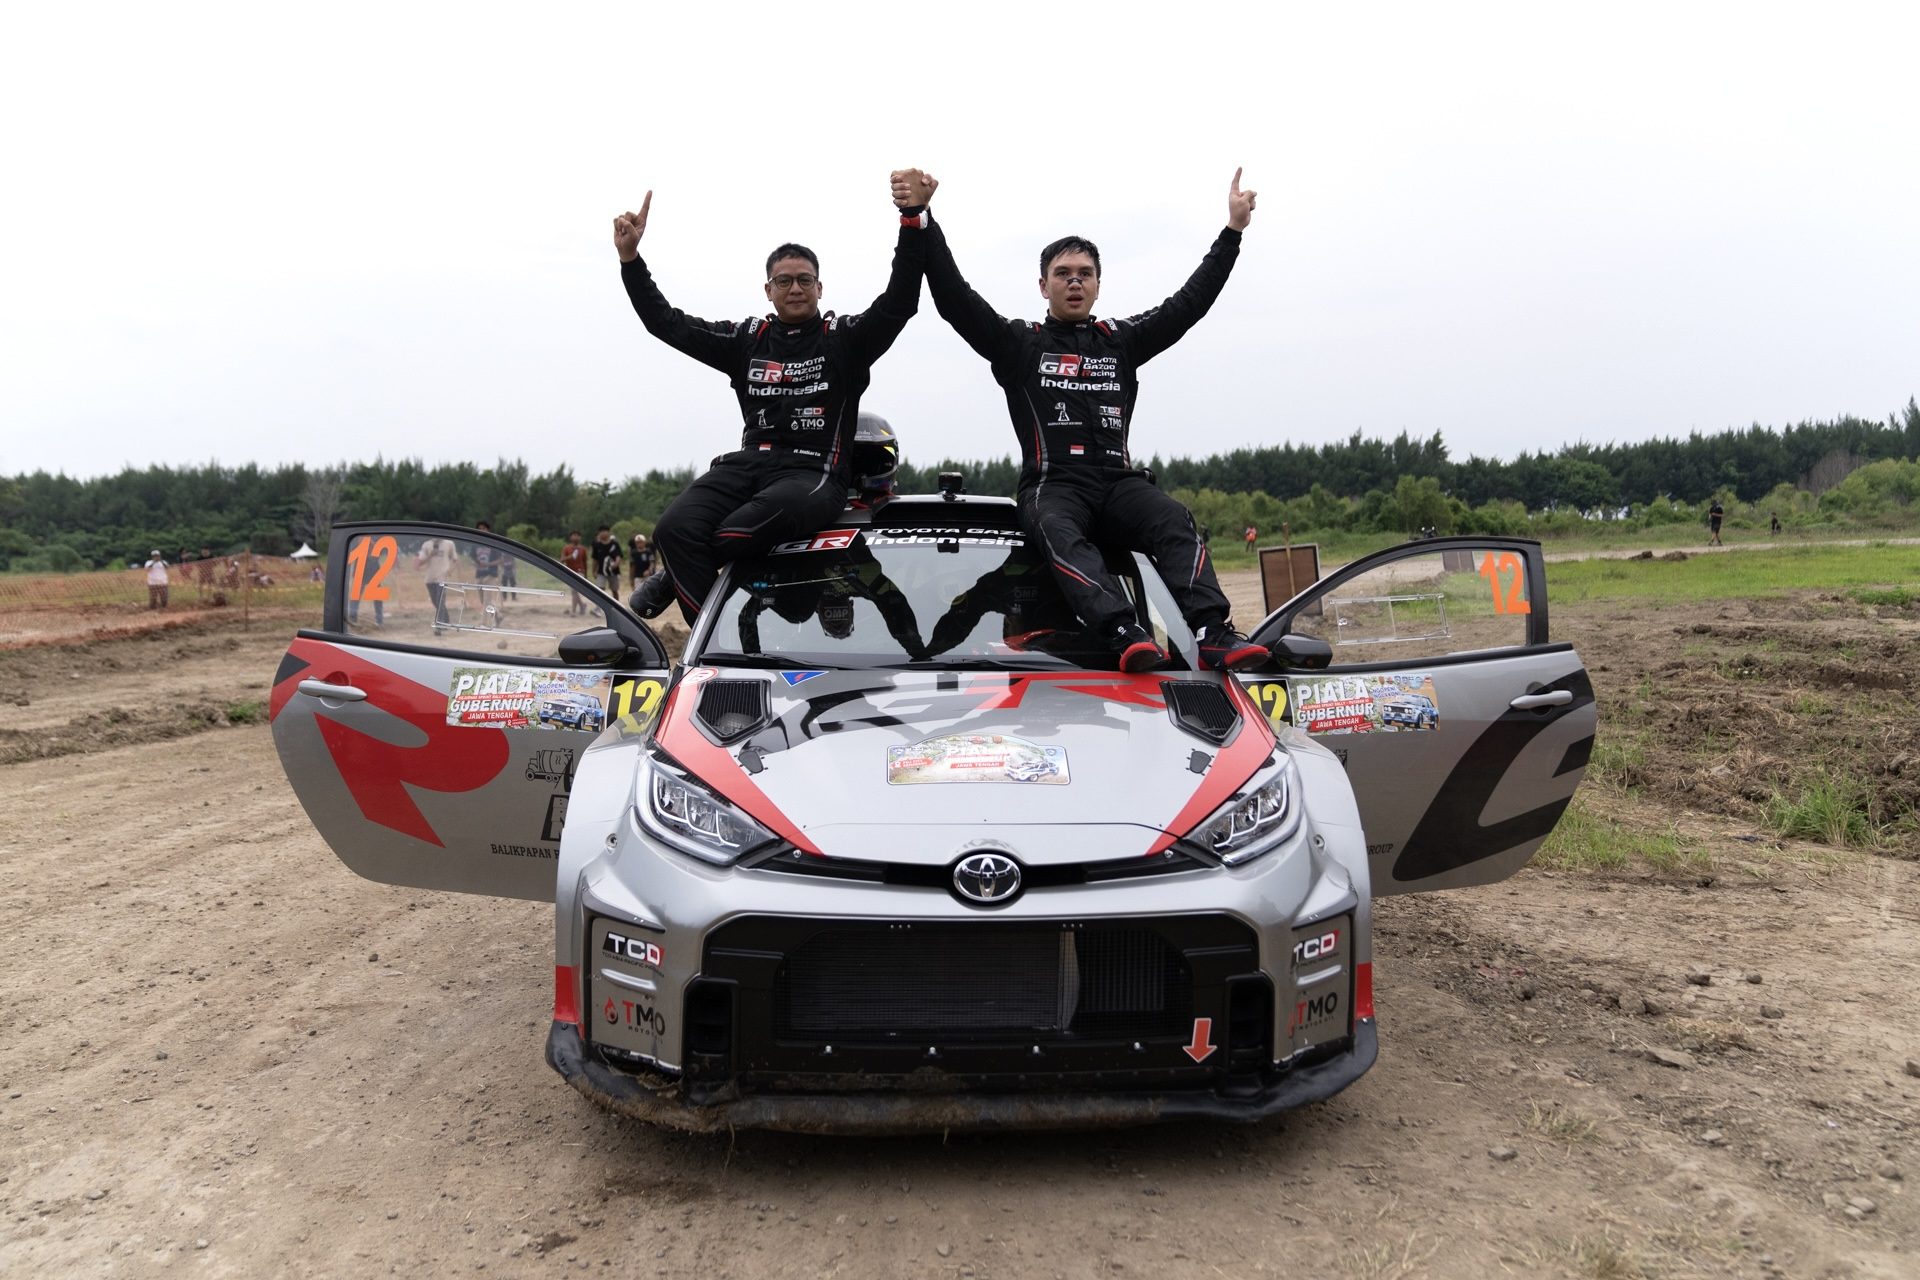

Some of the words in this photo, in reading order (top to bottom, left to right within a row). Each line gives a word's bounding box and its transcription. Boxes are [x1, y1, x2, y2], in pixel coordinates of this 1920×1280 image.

[786, 356, 826, 369] TOYOTA
[1083, 356, 1117, 364] TOYOTA
[748, 368, 782, 382] GR
[784, 365, 822, 376] GAZOO
[1040, 361, 1078, 376] GR
[1081, 370, 1116, 378] Racing
[783, 372, 821, 382] Racing
[1040, 376, 1121, 391] Indonesia
[748, 382, 829, 396] Indonesia
[795, 407, 825, 415] TCD
[800, 418, 825, 427] TMO
[1108, 417, 1122, 427] TMO
[780, 536, 850, 552] GR
[865, 535, 1025, 547] Indonesia
[348, 535, 398, 601] 12
[1480, 551, 1531, 614] 12
[824, 609, 849, 619] OMP
[455, 673, 534, 698] PIALA
[1296, 677, 1369, 707] PIALA
[450, 699, 534, 712] GUBERNUR
[614, 680, 664, 722] 12
[467, 712, 485, 720] JAWA
[486, 711, 513, 719] TENGAH
[1296, 703, 1374, 723] GUBERNUR
[1316, 720, 1333, 729] JAWA
[1334, 718, 1359, 727] TENGAH
[490, 843, 552, 859] BALIKPAPAN
[1366, 843, 1394, 855] ROUP
[608, 932, 661, 966] TCD
[1293, 932, 1336, 963] TCD
[1295, 991, 1338, 1025] TMO
[622, 1000, 666, 1036] TMO
